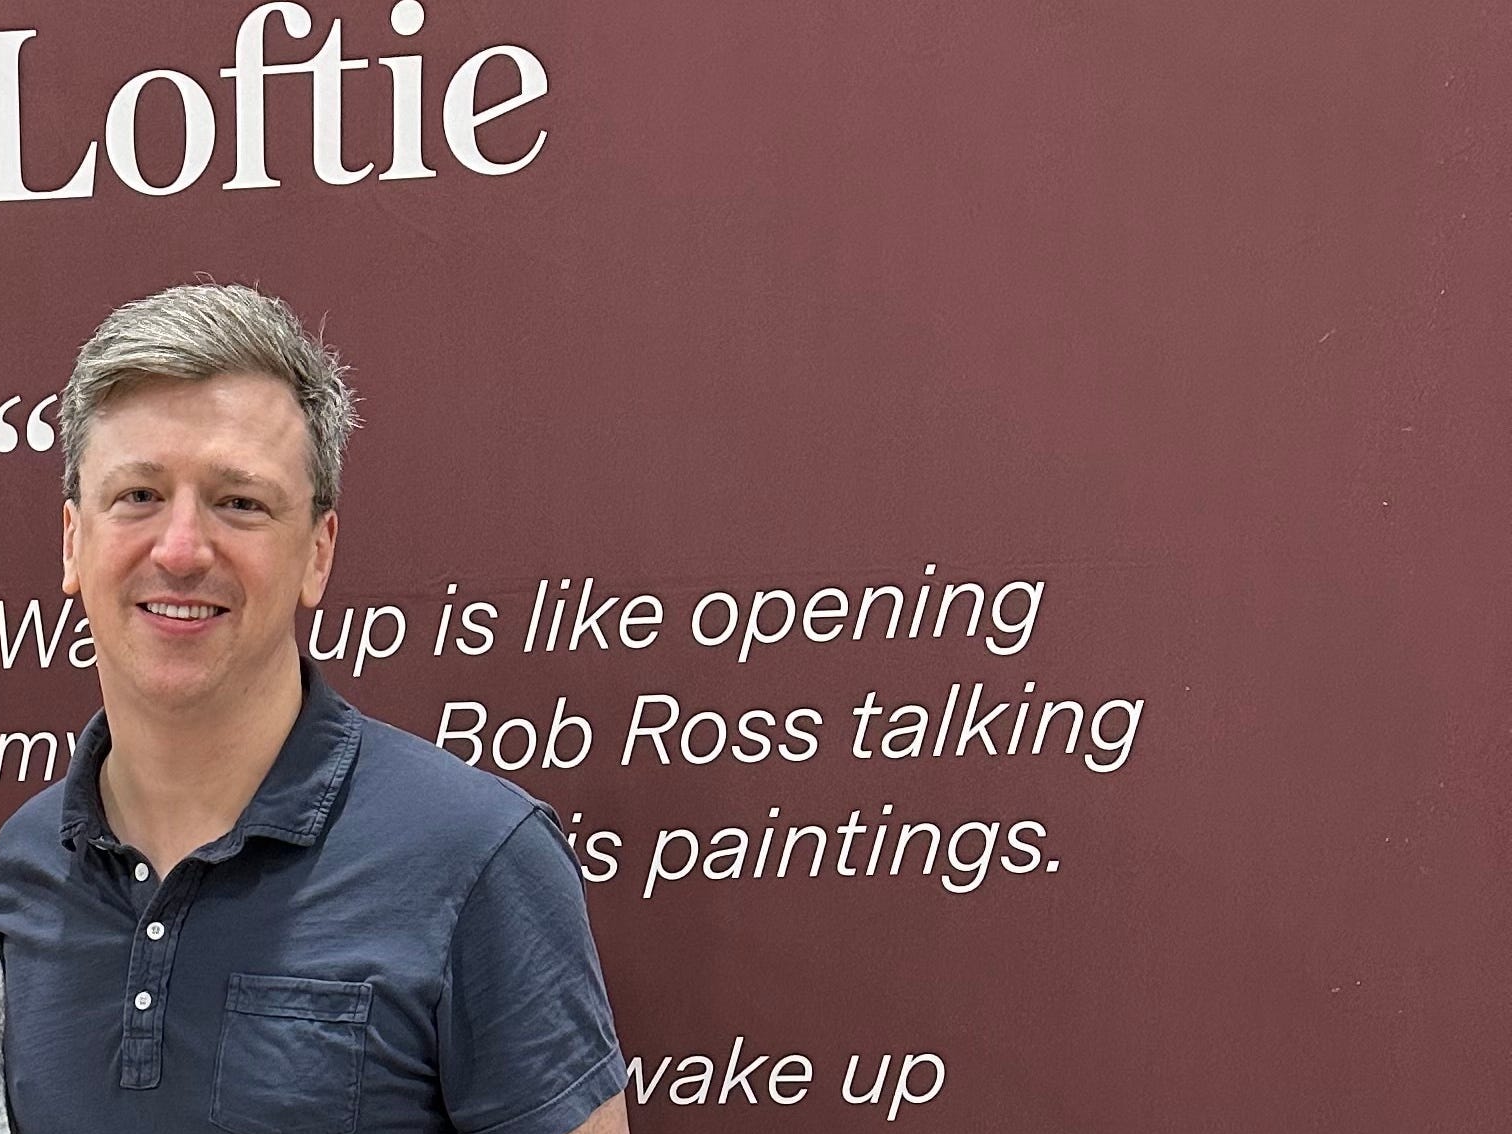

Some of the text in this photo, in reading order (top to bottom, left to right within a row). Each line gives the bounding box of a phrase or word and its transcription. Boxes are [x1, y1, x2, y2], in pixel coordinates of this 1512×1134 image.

[309, 564, 1045, 678] up is like opening
[435, 696, 592, 771] Bob
[620, 694, 823, 766] Ross
[852, 681, 1145, 773] talking
[643, 804, 1060, 899] paintings.
[626, 1036, 945, 1121] wake up
